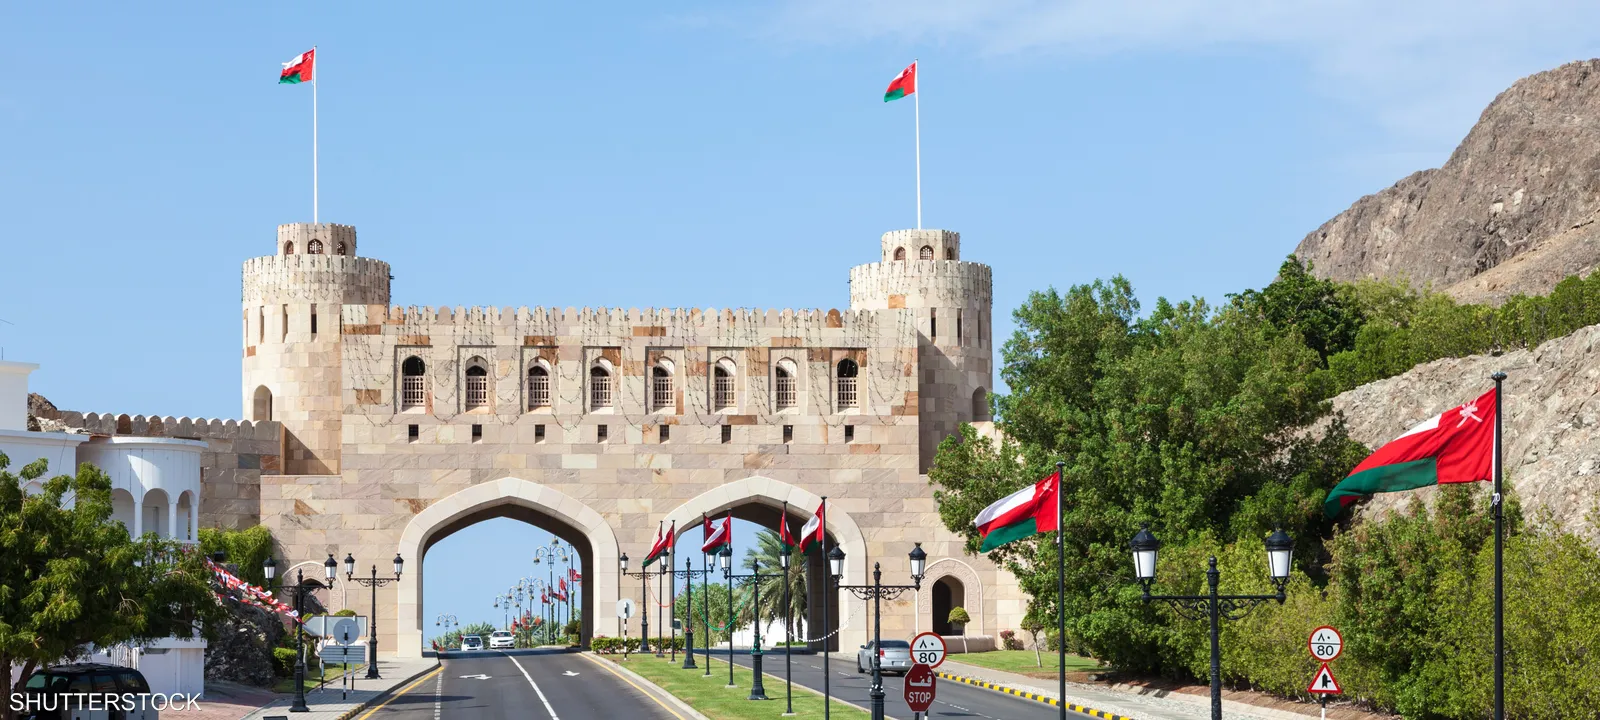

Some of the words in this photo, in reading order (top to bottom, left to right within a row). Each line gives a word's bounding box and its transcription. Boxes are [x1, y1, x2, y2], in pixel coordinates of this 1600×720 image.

[1318, 633, 1331, 641] ٨٠
[920, 640, 934, 649] ٨٠
[1317, 645, 1334, 656] 80
[919, 652, 937, 663] 80
[909, 672, 932, 686] قف
[908, 692, 931, 703] STOP
